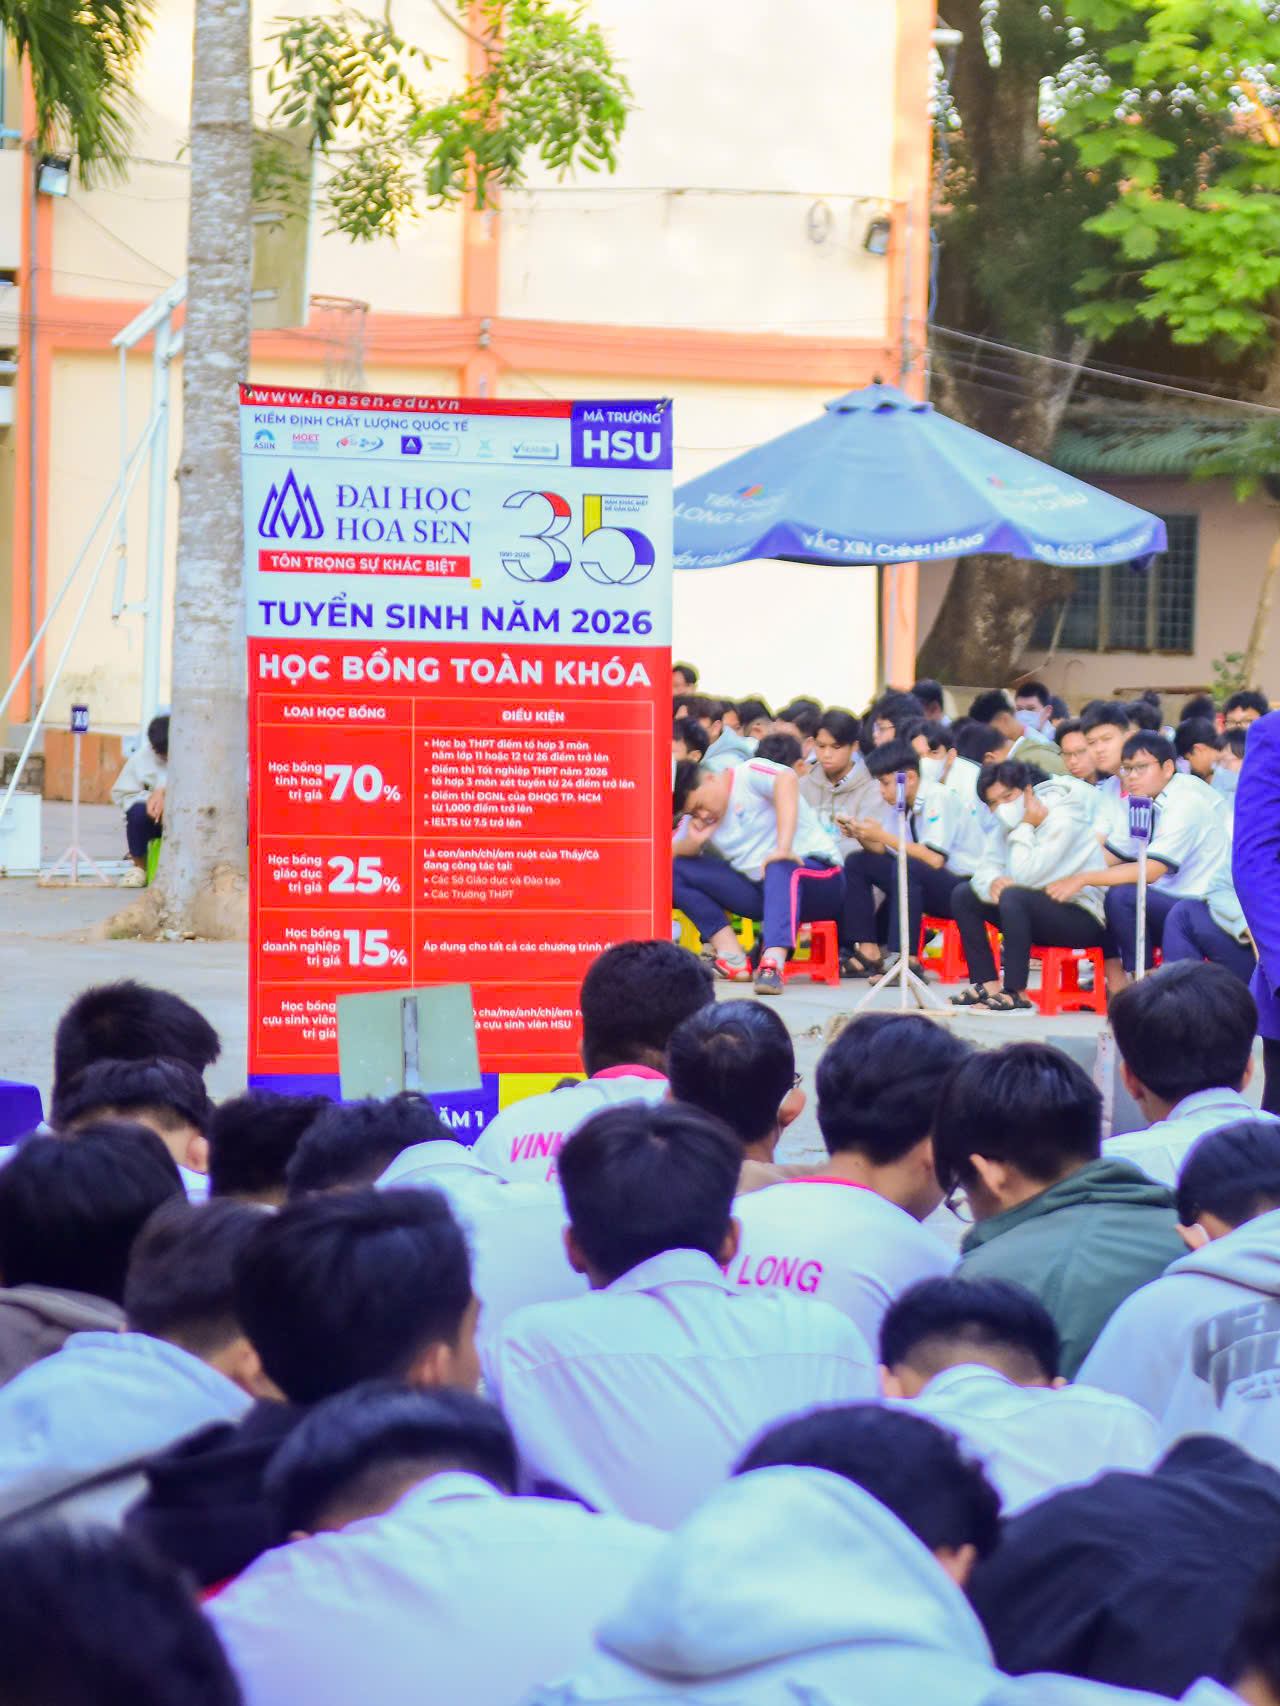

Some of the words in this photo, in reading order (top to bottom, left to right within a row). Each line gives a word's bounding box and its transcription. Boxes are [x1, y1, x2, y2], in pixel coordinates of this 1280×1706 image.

[254, 389, 460, 411] www.hoasen.edu.vn
[290, 414, 323, 429] ĐỊNH
[326, 412, 360, 429] CHẤT
[364, 417, 408, 431] LƯỢNG
[412, 418, 453, 433] QUỐC
[454, 418, 469, 433] TẾ
[583, 409, 605, 423] MÃ
[607, 409, 661, 425] TRƯỜNG
[583, 430, 661, 462] HSU
[336, 484, 392, 513] ĐẠI
[401, 486, 472, 514] HỌC
[336, 517, 405, 542] HOA
[413, 519, 472, 545] SEN
[501, 489, 656, 585] 35
[844, 540, 873, 556] XIN
[270, 551, 301, 568] TÔN
[306, 556, 355, 572] TRỌNG
[359, 556, 381, 572] SỰ
[383, 554, 422, 571] KHÁC
[426, 559, 457, 575] BIỆT
[258, 592, 375, 629] TUYỂN
[385, 604, 469, 631] SINH
[481, 599, 561, 633] NĂM
[571, 608, 654, 636] 2026
[258, 653, 331, 687] HỌC
[342, 646, 441, 684] BỔNG
[450, 651, 544, 685] TOÀN
[554, 656, 653, 687] KHÓA
[283, 706, 314, 719] LOẠI
[317, 706, 345, 720] HỌC
[535, 709, 565, 723] KIỆN
[431, 739, 451, 749] Học
[469, 739, 495, 748] THPT
[558, 740, 565, 749] 3
[566, 740, 589, 750] môn
[475, 751, 482, 760] 11
[511, 751, 521, 760] 12
[536, 752, 548, 761] 26
[594, 752, 609, 762] lên
[268, 762, 289, 773] Học
[461, 764, 475, 774] thi
[532, 766, 558, 776] THPT
[584, 767, 608, 776] 2026
[275, 775, 298, 786] tinh
[300, 775, 323, 786] hoa
[324, 764, 401, 803] 70%
[466, 777, 473, 786] 3
[475, 777, 497, 786] môn
[288, 789, 302, 801] trị
[304, 789, 323, 802] giá
[461, 791, 475, 800] thi
[477, 791, 505, 801] ĐGNL
[528, 792, 558, 803] ĐHQG
[561, 792, 575, 801] TP.
[577, 792, 601, 802] HCM
[431, 817, 458, 827] IELTS
[268, 854, 289, 866] Học
[423, 861, 449, 871] đang
[451, 861, 477, 872] công
[479, 861, 495, 870] tác
[273, 868, 298, 880] giáo
[300, 868, 323, 880] dục
[327, 855, 401, 894] 25%
[431, 875, 449, 885] Các
[466, 874, 488, 885] Giáo
[288, 882, 301, 894] trị
[303, 882, 322, 894] giá
[431, 888, 449, 898] Các
[489, 890, 513, 899] THPT
[285, 928, 307, 939] Học
[262, 940, 297, 951] doanh
[300, 940, 341, 953] nghiệp
[343, 929, 408, 966] 15%
[439, 941, 466, 952] dụng
[468, 941, 487, 950] cho
[519, 941, 537, 950] các
[306, 955, 320, 967] trị
[322, 955, 341, 967] giá
[281, 1001, 304, 1012] Học
[262, 1015, 282, 1027] cựu
[284, 1014, 309, 1025] sinh
[311, 1014, 336, 1025] viên
[504, 1020, 525, 1029] sinh
[550, 1020, 571, 1030] HSU
[303, 1028, 316, 1040] trị
[318, 1028, 336, 1040] giá
[475, 1110, 484, 1128] 1
[736, 1254, 824, 1294] LONG
